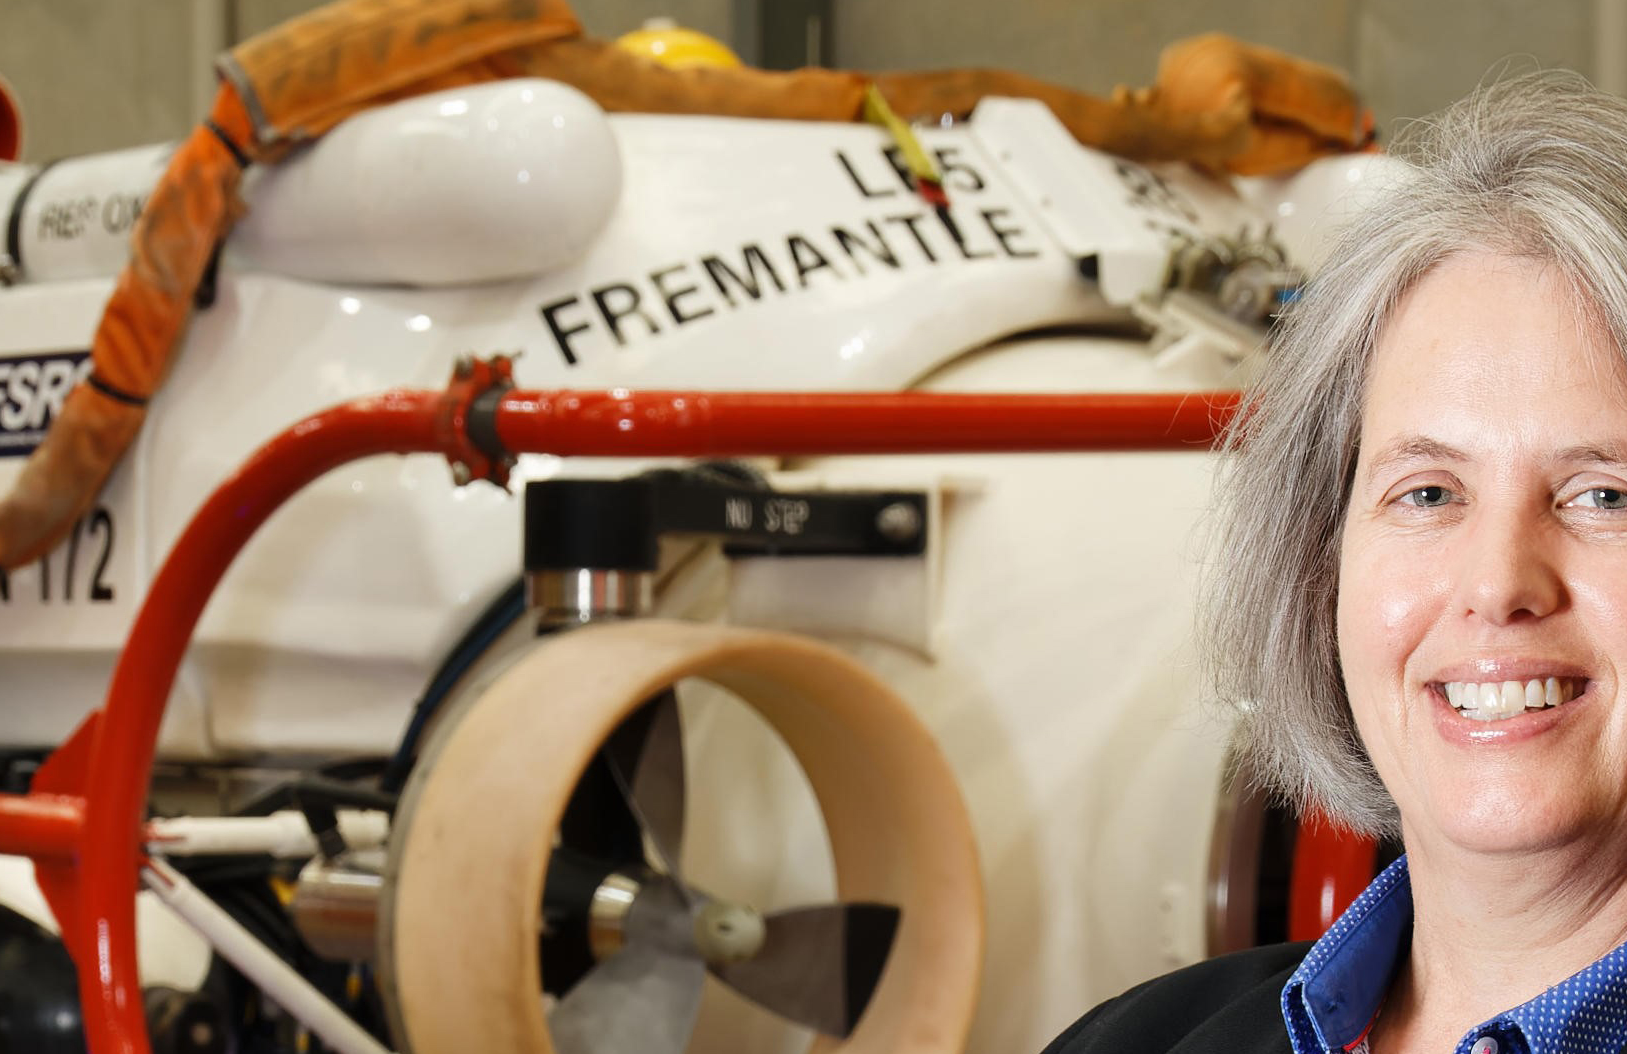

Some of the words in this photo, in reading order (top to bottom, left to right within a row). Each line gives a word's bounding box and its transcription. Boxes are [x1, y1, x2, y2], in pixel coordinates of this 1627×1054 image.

[540, 208, 1038, 367] FREMANTLE
[725, 497, 753, 530] NO
[764, 499, 810, 534] STEP
